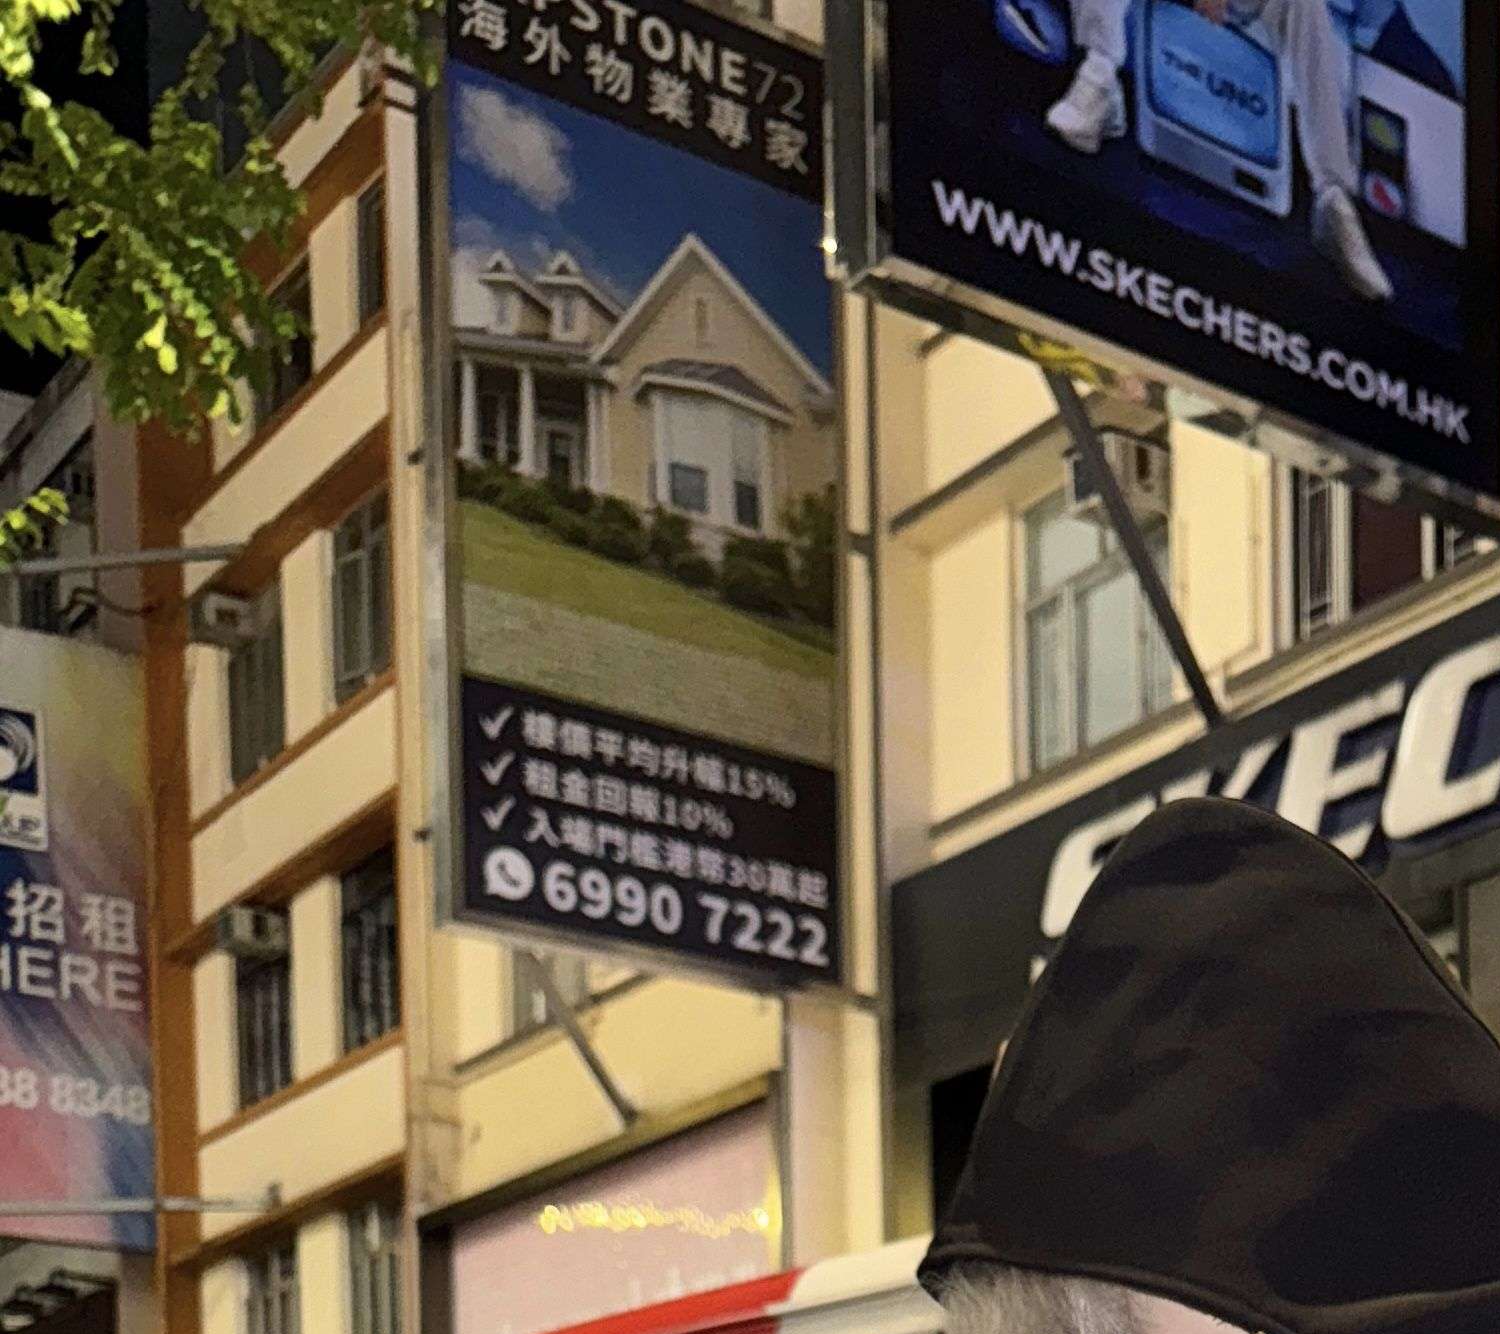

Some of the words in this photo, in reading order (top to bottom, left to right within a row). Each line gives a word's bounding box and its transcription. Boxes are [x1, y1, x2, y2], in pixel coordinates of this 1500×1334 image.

[458, 0, 808, 174] 海外物業專家
[931, 180, 1471, 443] WWW.SKECHERS.COM.HK
[5, 876, 139, 956] 招租
[541, 859, 683, 935] 6990
[697, 894, 831, 968] 7222
